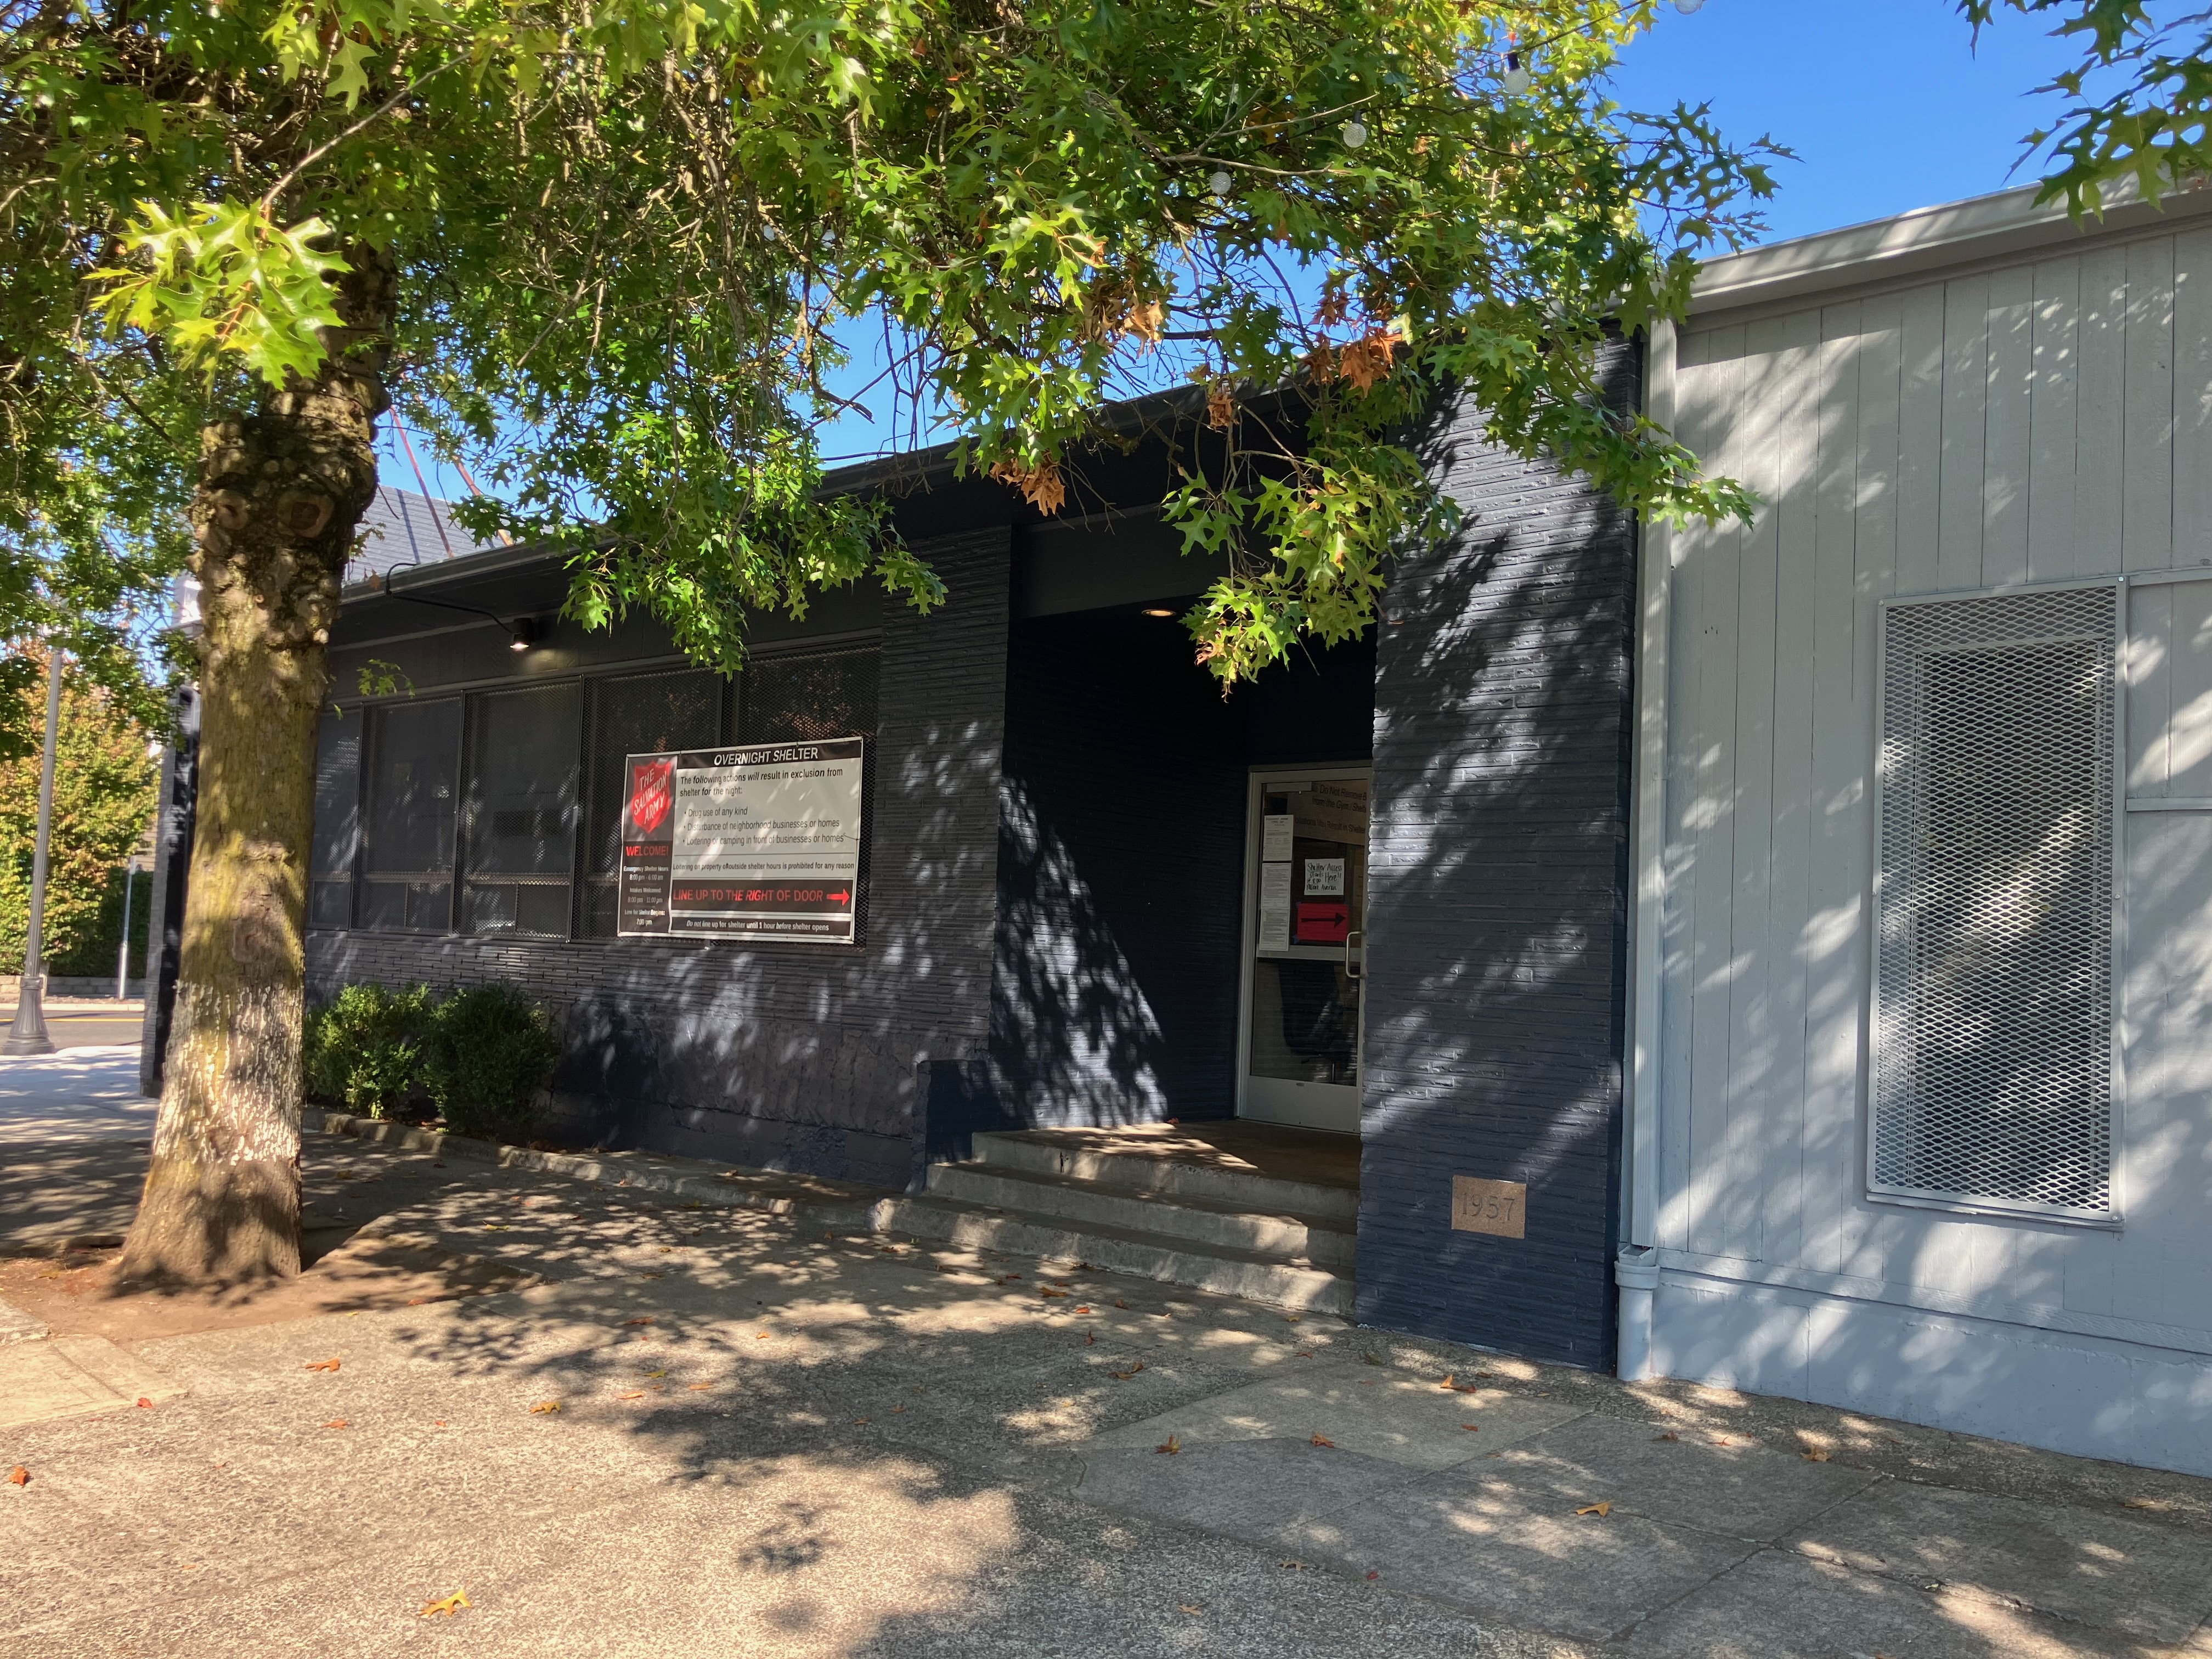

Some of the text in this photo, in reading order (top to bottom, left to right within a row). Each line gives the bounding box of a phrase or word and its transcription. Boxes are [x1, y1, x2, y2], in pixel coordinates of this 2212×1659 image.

[714, 747, 819, 766] OVERNIGHT SHELTER
[639, 768, 654, 790] THE
[693, 775, 722, 785] following
[723, 773, 746, 782] actions
[747, 772, 760, 780] will
[760, 770, 781, 780] result
[782, 770, 788, 779] in
[791, 768, 825, 778] exclusion
[827, 768, 843, 777] from
[634, 770, 667, 816] SALVATION
[680, 786, 743, 797] shelter for the night:
[644, 791, 665, 825] ARMY
[689, 809, 702, 818] Drug
[715, 807, 721, 816] of
[721, 808, 733, 817] any
[735, 806, 748, 815] kind
[687, 823, 721, 831] Disturbance
[723, 822, 729, 830] of
[729, 820, 771, 832] neighborhood
[772, 819, 808, 828] businesses
[818, 819, 839, 827] homes
[1295, 816, 1316, 826] olations
[687, 837, 711, 847] Loitering
[720, 836, 744, 847] camping
[746, 836, 752, 844] in
[753, 836, 767, 844] front
[776, 834, 811, 843] businesses
[822, 833, 844, 843] homes
[626, 845, 669, 856] WELCOME!
[702, 864, 722, 872] property
[788, 862, 814, 871] prohibited
[673, 889, 823, 902] LINE UP TO THE RIGHT OF DOOR
[727, 921, 745, 929] shelter
[1463, 1193, 1515, 1221] 1957
